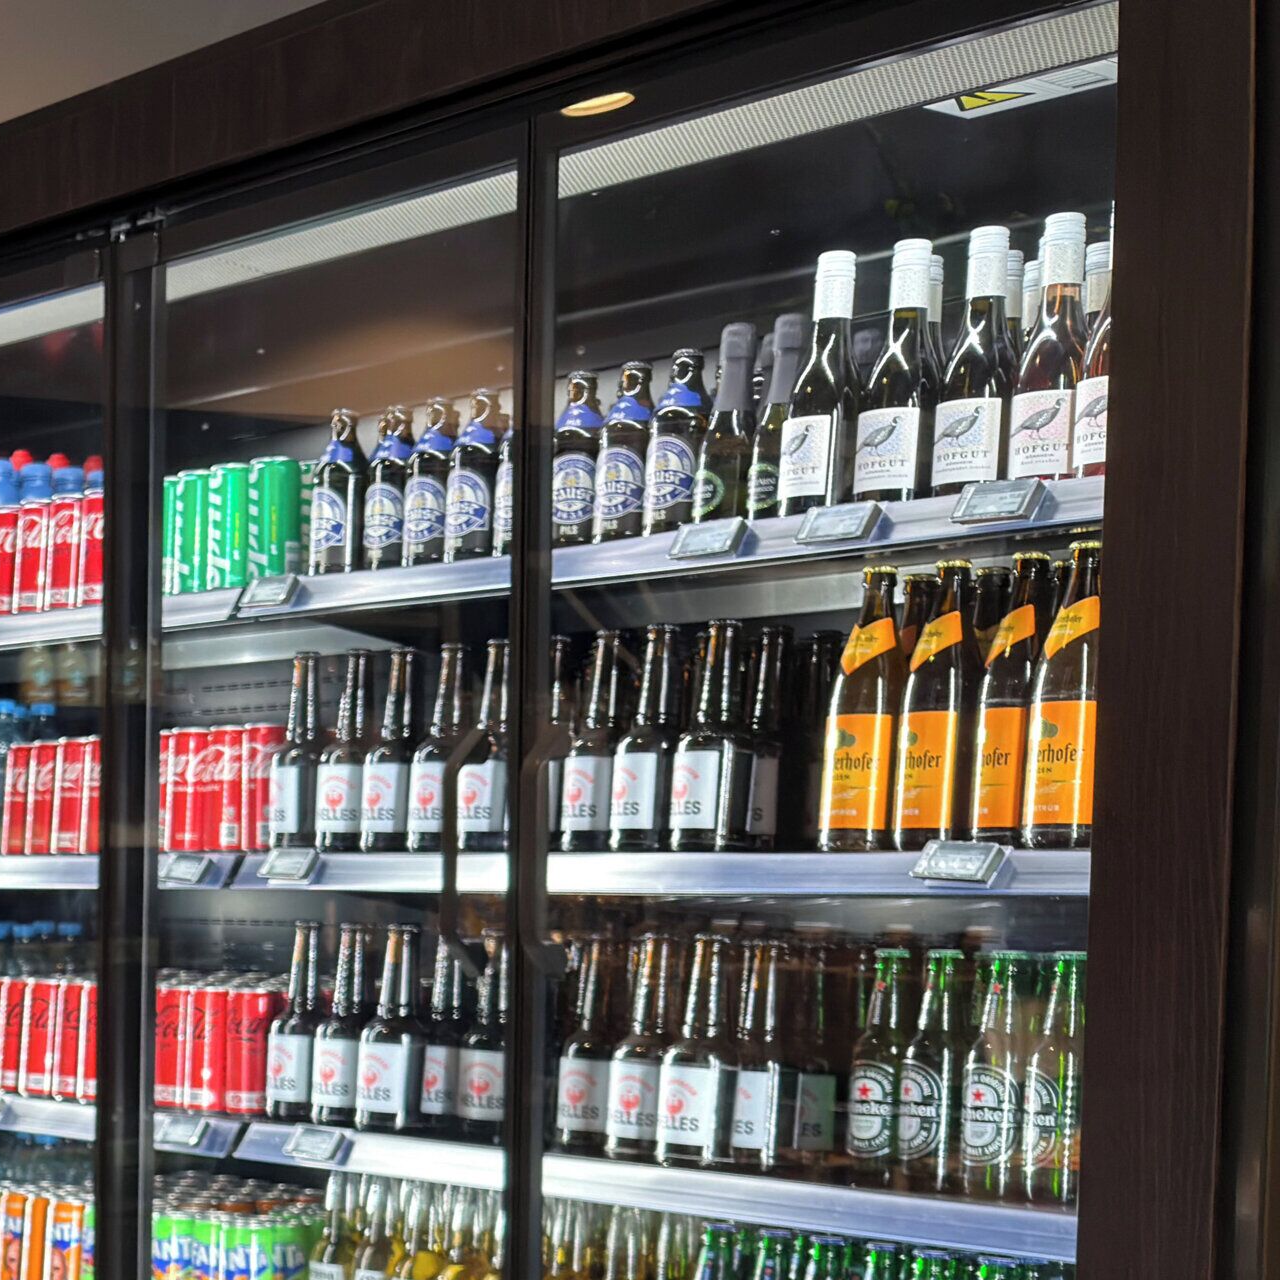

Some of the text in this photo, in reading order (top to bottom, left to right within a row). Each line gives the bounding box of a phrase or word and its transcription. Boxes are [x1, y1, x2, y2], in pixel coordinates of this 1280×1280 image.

[1077, 432, 1106, 445] HOFG
[1015, 442, 1070, 456] HOFGUT
[936, 450, 988, 464] HOFGUT
[559, 525, 579, 535] PILS
